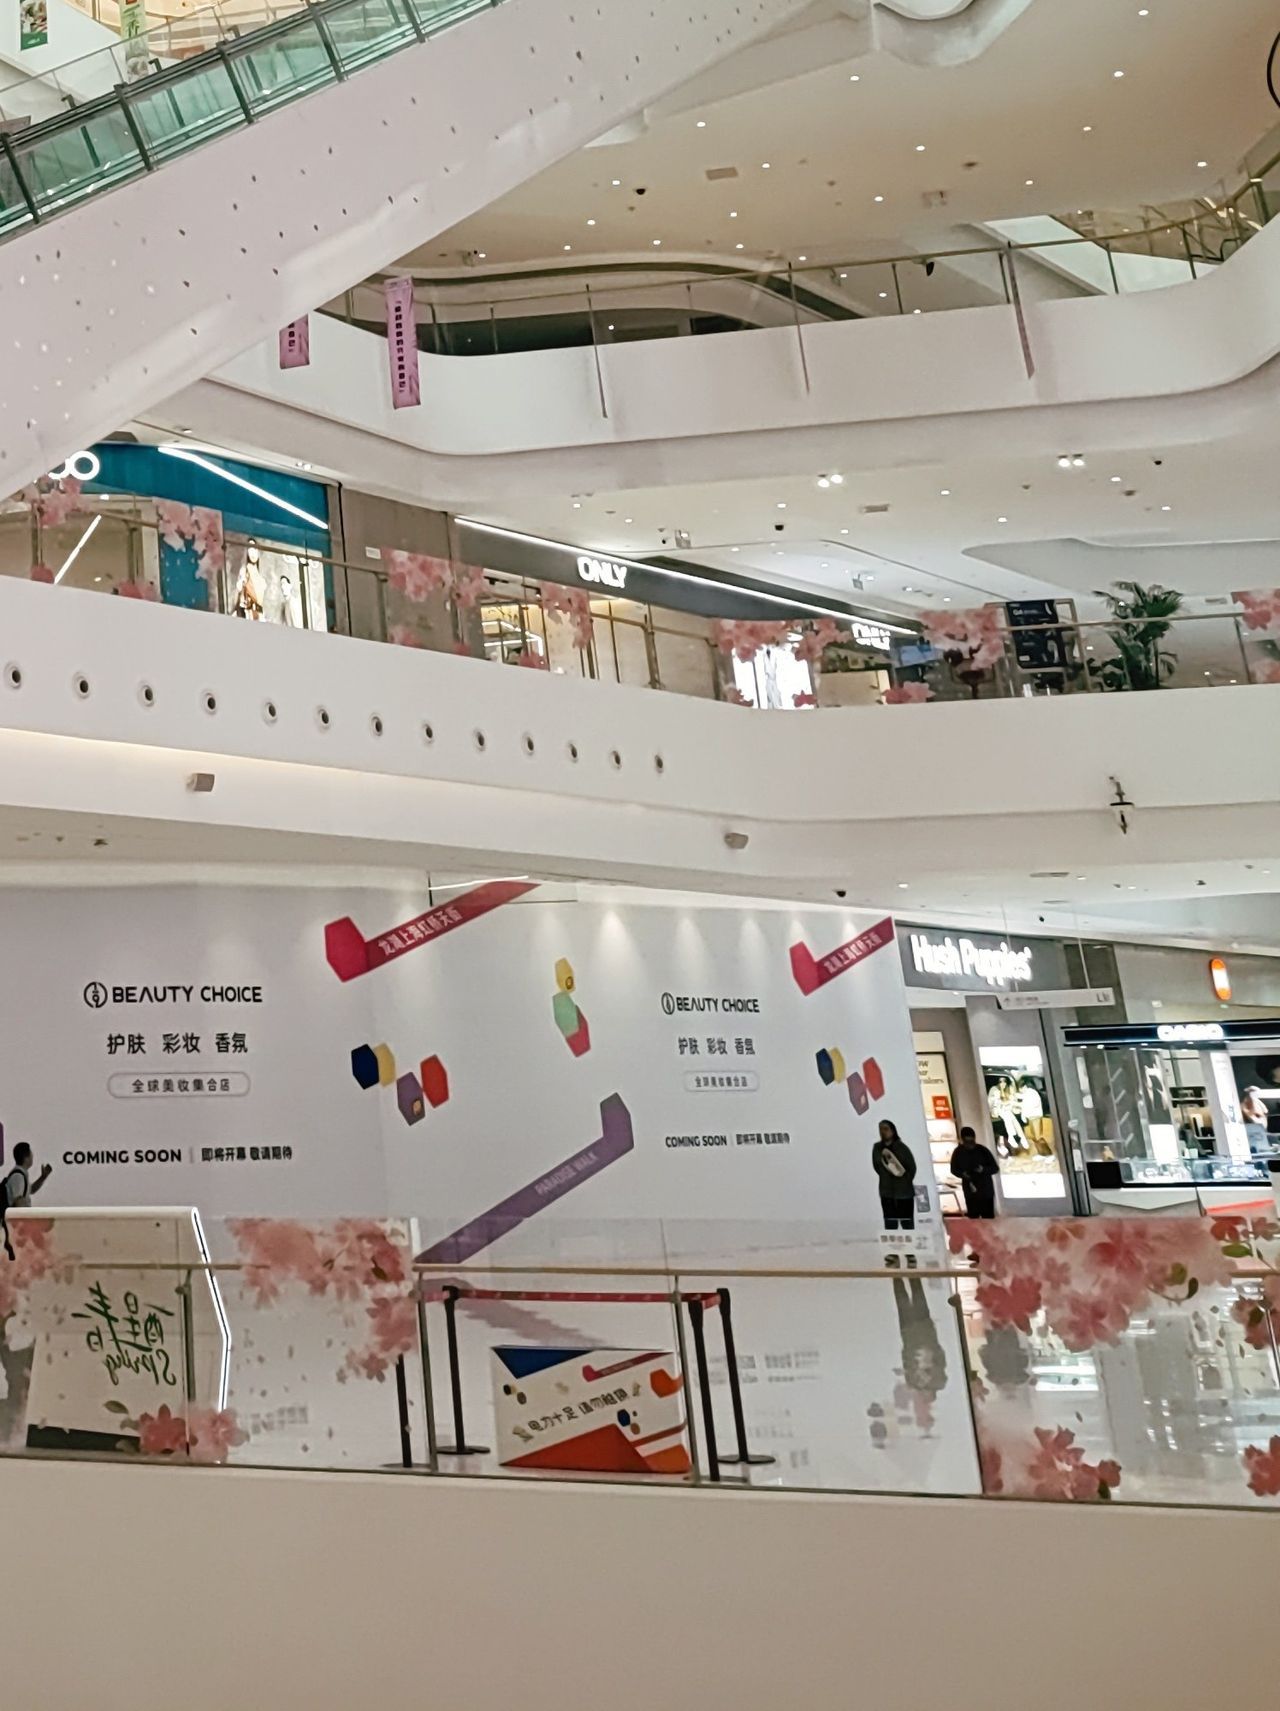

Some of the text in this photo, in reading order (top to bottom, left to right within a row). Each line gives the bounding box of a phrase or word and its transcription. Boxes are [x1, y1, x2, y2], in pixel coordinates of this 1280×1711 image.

[577, 556, 627, 588] ONLY
[910, 934, 963, 975] Hush
[112, 986, 263, 1003] BEAUTY CHOICE
[676, 997, 760, 1013] BEAUTY CHOICE
[107, 1032, 248, 1054] 护肤 彩妆 香氛
[665, 1136, 700, 1147] COMING
[702, 1135, 727, 1146] SOON
[62, 1150, 129, 1164] COMING
[134, 1149, 182, 1163] SOON
